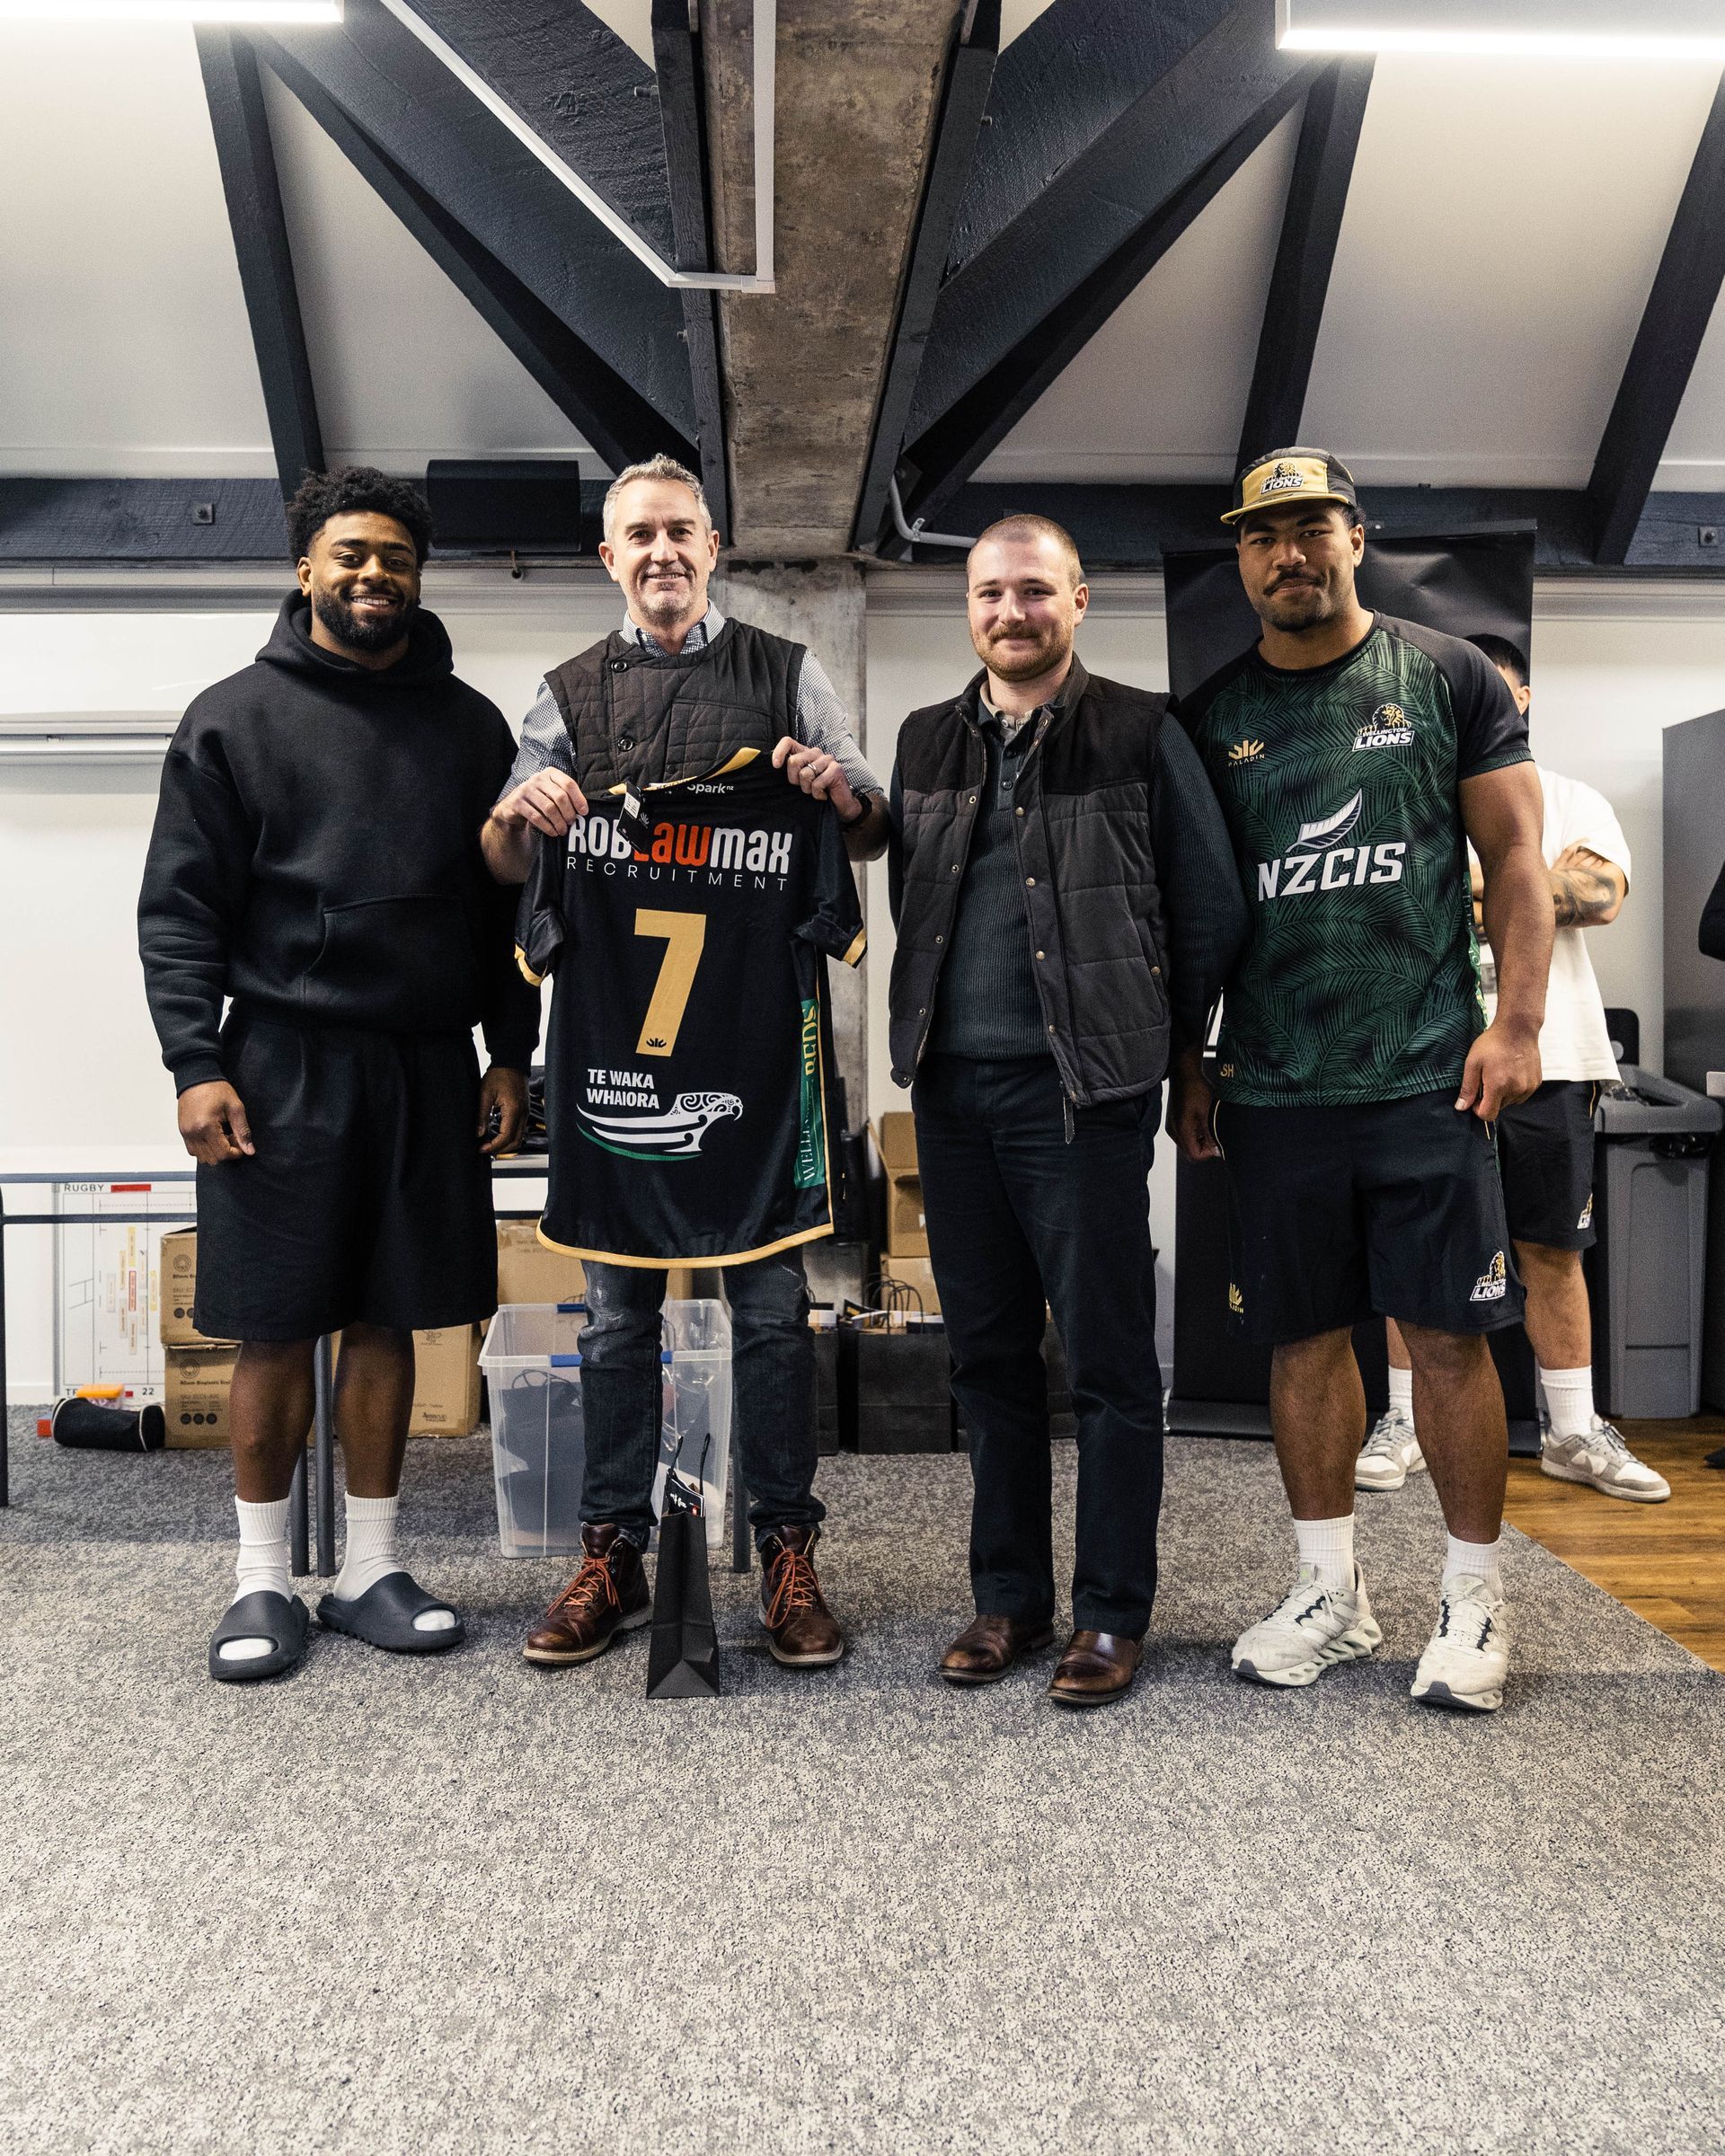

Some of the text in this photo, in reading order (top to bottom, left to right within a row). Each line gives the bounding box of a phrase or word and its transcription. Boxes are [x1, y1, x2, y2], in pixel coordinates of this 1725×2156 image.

[1261, 477, 1303, 493] LIONS
[1355, 732, 1412, 749] LIONS
[1228, 754, 1265, 767] PALADIN
[687, 782, 726, 795] Spark
[567, 856, 787, 891] RECRUITMENT
[1257, 843, 1406, 902] NZCIS
[634, 908, 707, 1057] 7
[1220, 1063, 1234, 1078] SH
[588, 1068, 654, 1090] TE WAKA
[586, 1088, 660, 1109] WHAIORA
[64, 1183, 104, 1192] RUGBY
[142, 1387, 155, 1396] 22
